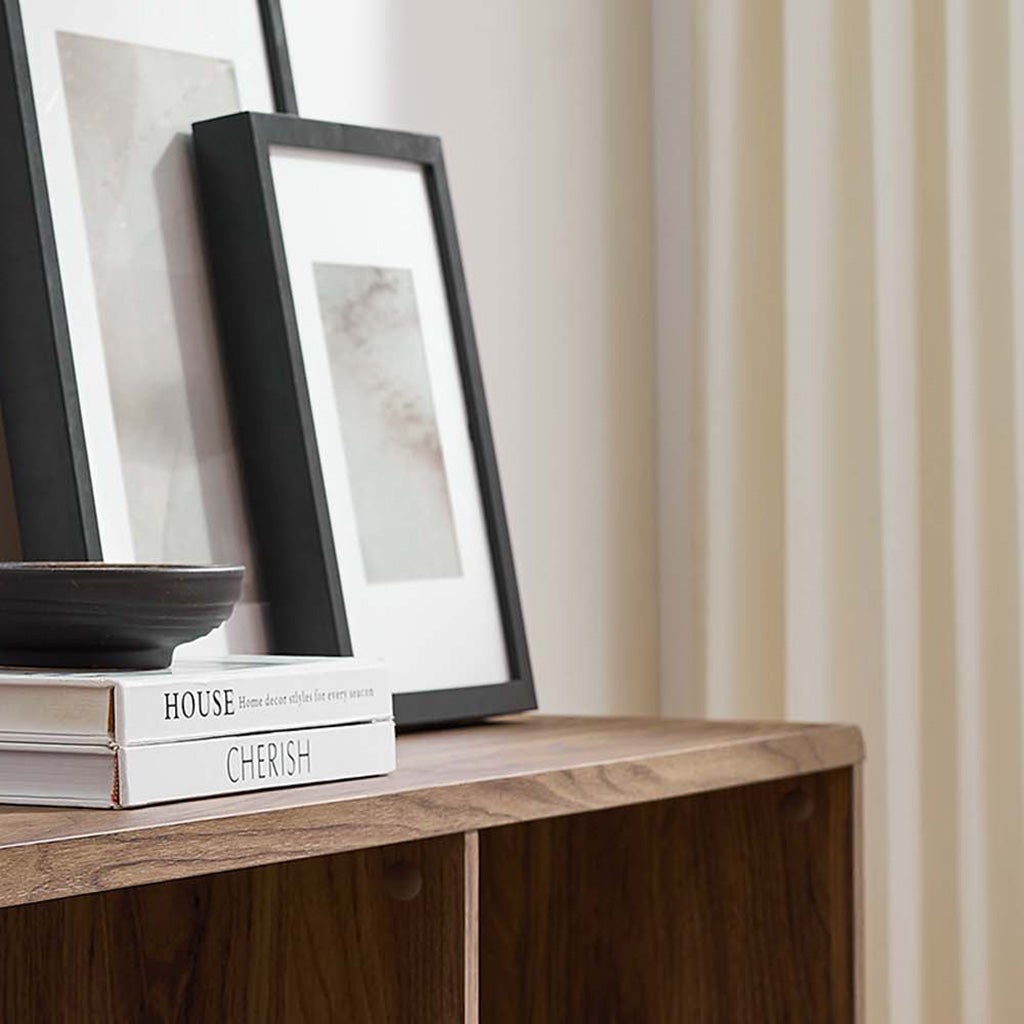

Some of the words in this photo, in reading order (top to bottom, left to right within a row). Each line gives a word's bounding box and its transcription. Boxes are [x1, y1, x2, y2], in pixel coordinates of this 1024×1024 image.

[164, 689, 235, 720] HOUSE
[238, 695, 263, 709] Home
[265, 692, 287, 707] decor
[327, 689, 347, 704] every
[226, 738, 312, 783] CHERISH
